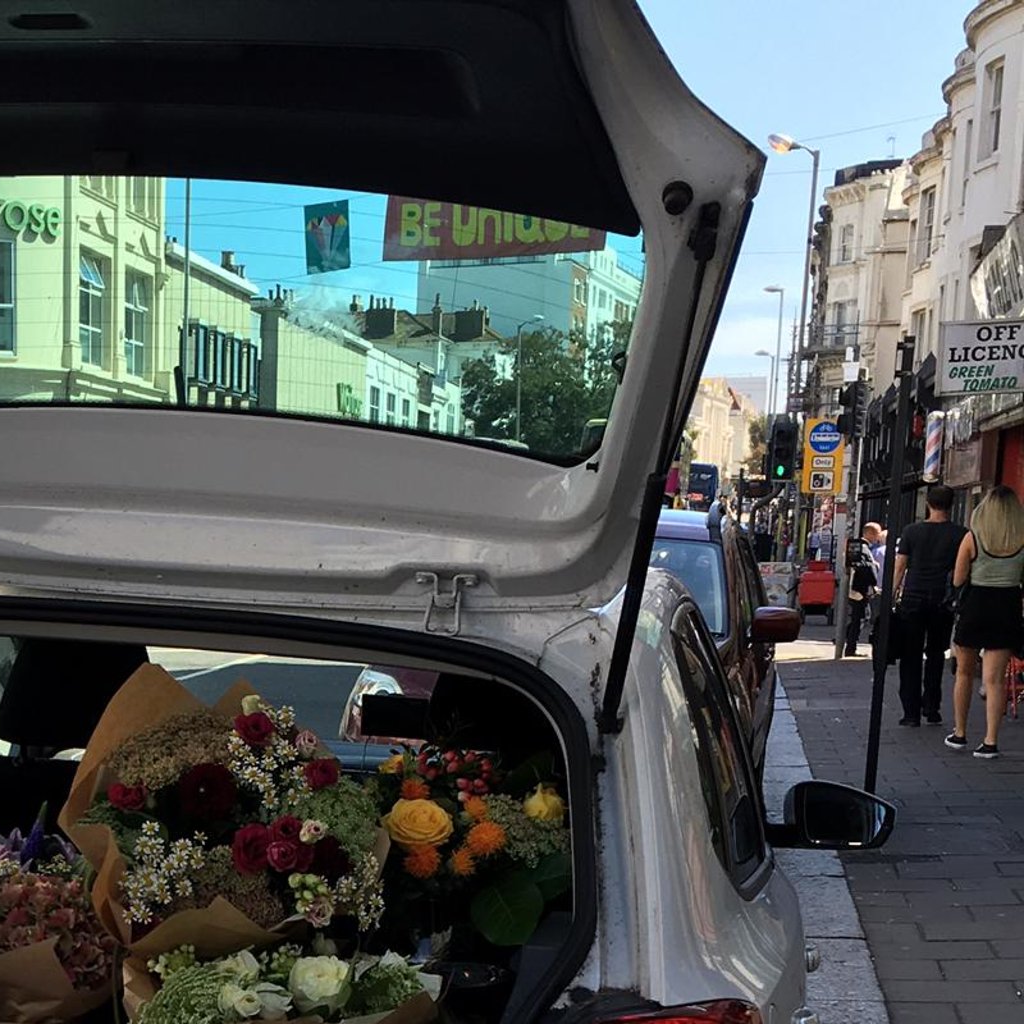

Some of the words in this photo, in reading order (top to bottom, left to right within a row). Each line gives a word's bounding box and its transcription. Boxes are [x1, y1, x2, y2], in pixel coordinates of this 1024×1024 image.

[400, 203, 441, 247] BE
[976, 325, 1022, 342] OFF
[949, 365, 995, 379] GREEN
[963, 376, 1018, 392] TOMATO
